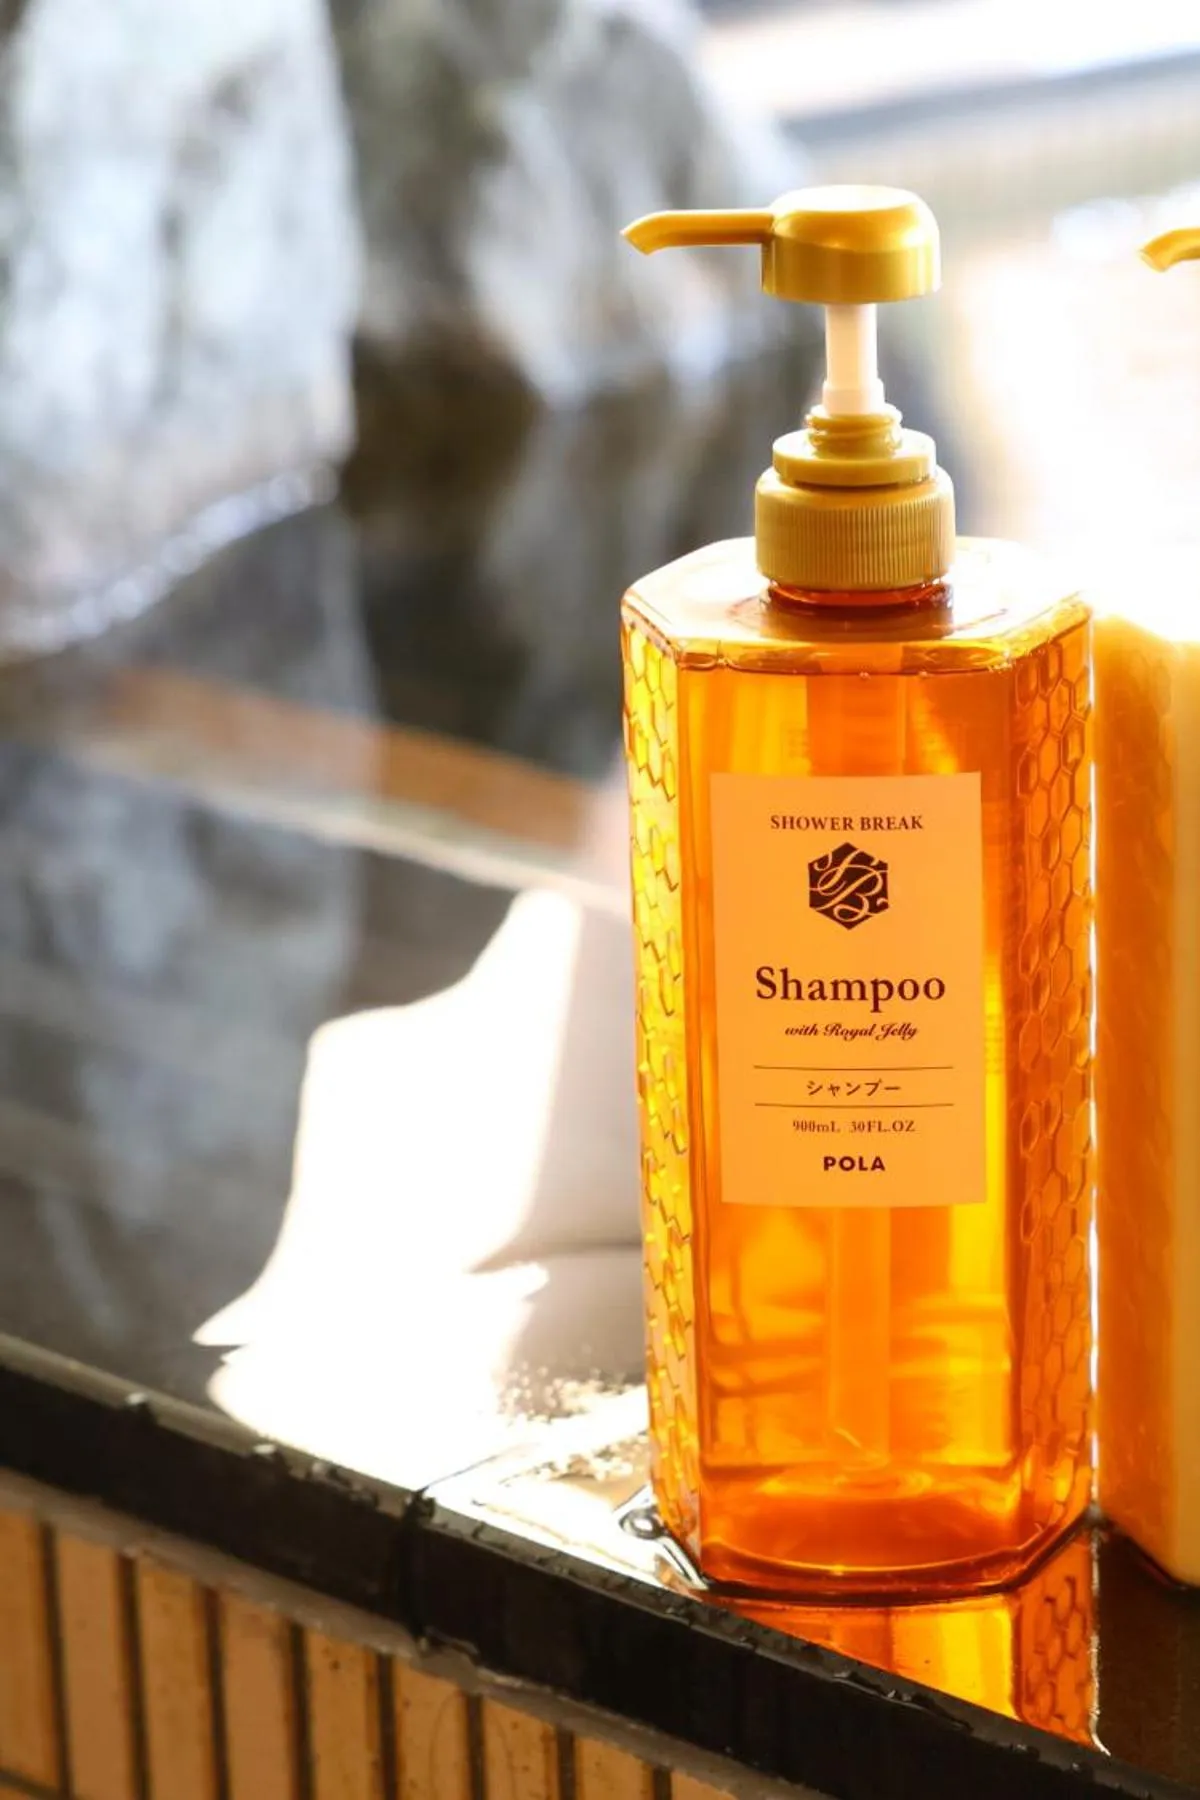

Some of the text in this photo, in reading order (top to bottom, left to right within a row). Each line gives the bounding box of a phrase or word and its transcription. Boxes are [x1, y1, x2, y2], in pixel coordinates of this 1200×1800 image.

[770, 815, 923, 832] SHOWER BREAK
[755, 965, 946, 1014] Shampoo
[784, 1023, 918, 1041] with Royal Jelly
[806, 1078, 901, 1097] シャンプー
[793, 1119, 841, 1133] 900mL
[823, 1155, 886, 1172] POLA
